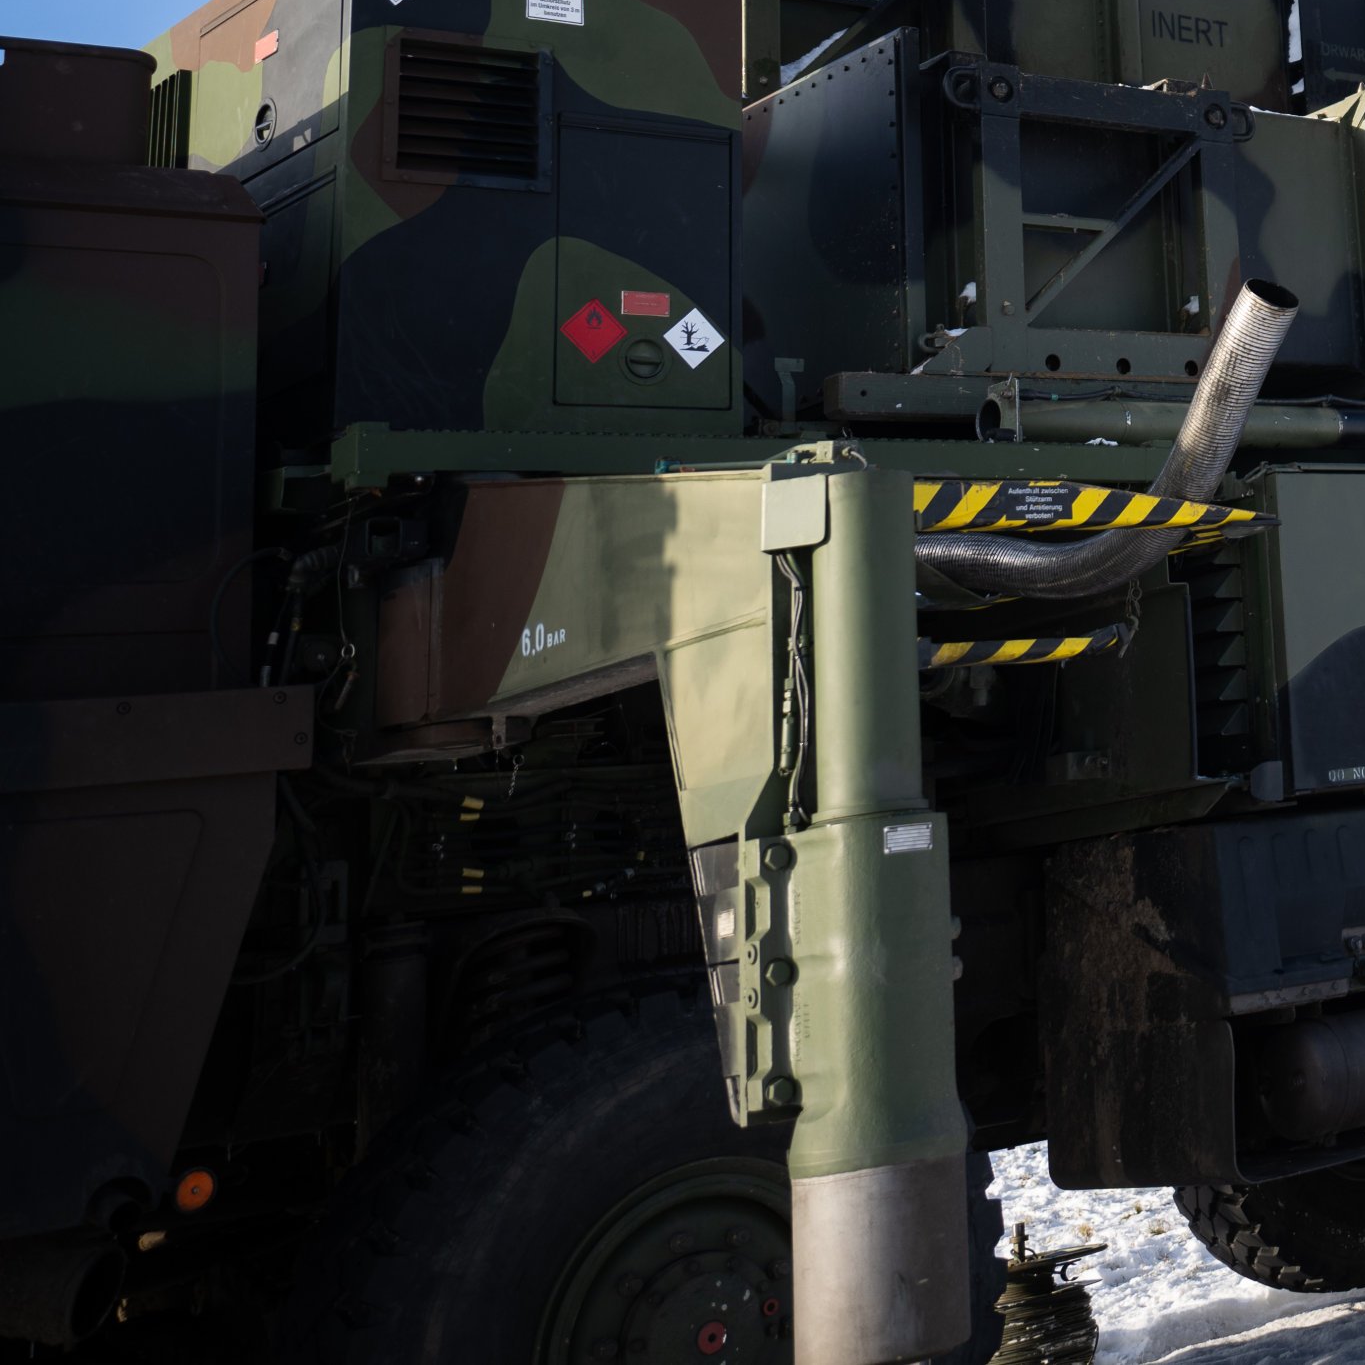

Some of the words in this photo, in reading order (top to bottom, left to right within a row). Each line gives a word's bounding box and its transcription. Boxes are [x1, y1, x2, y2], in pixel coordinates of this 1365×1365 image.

[1151, 10, 1228, 48] INERT
[522, 623, 545, 657] 6,0
[547, 628, 566, 648] BAR
